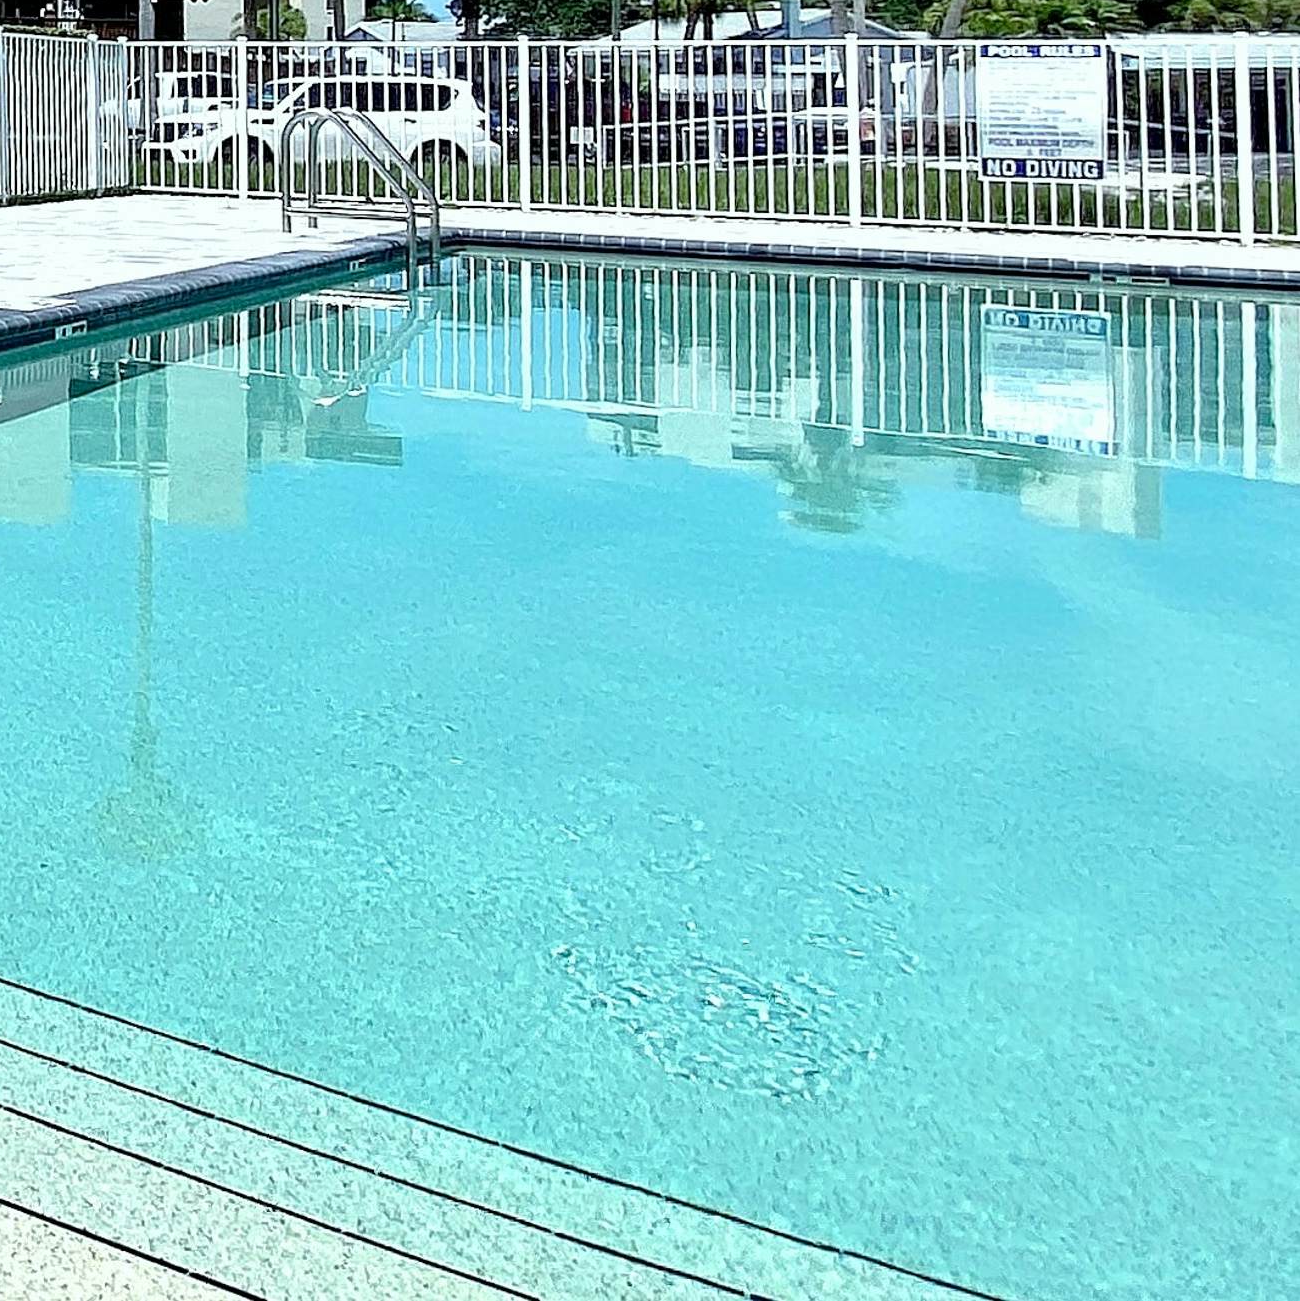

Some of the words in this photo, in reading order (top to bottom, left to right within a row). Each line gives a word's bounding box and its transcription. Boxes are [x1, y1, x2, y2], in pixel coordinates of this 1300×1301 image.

[987, 45, 1033, 57] POOL
[986, 159, 1016, 177] NO
[1026, 159, 1099, 178] DIVING
